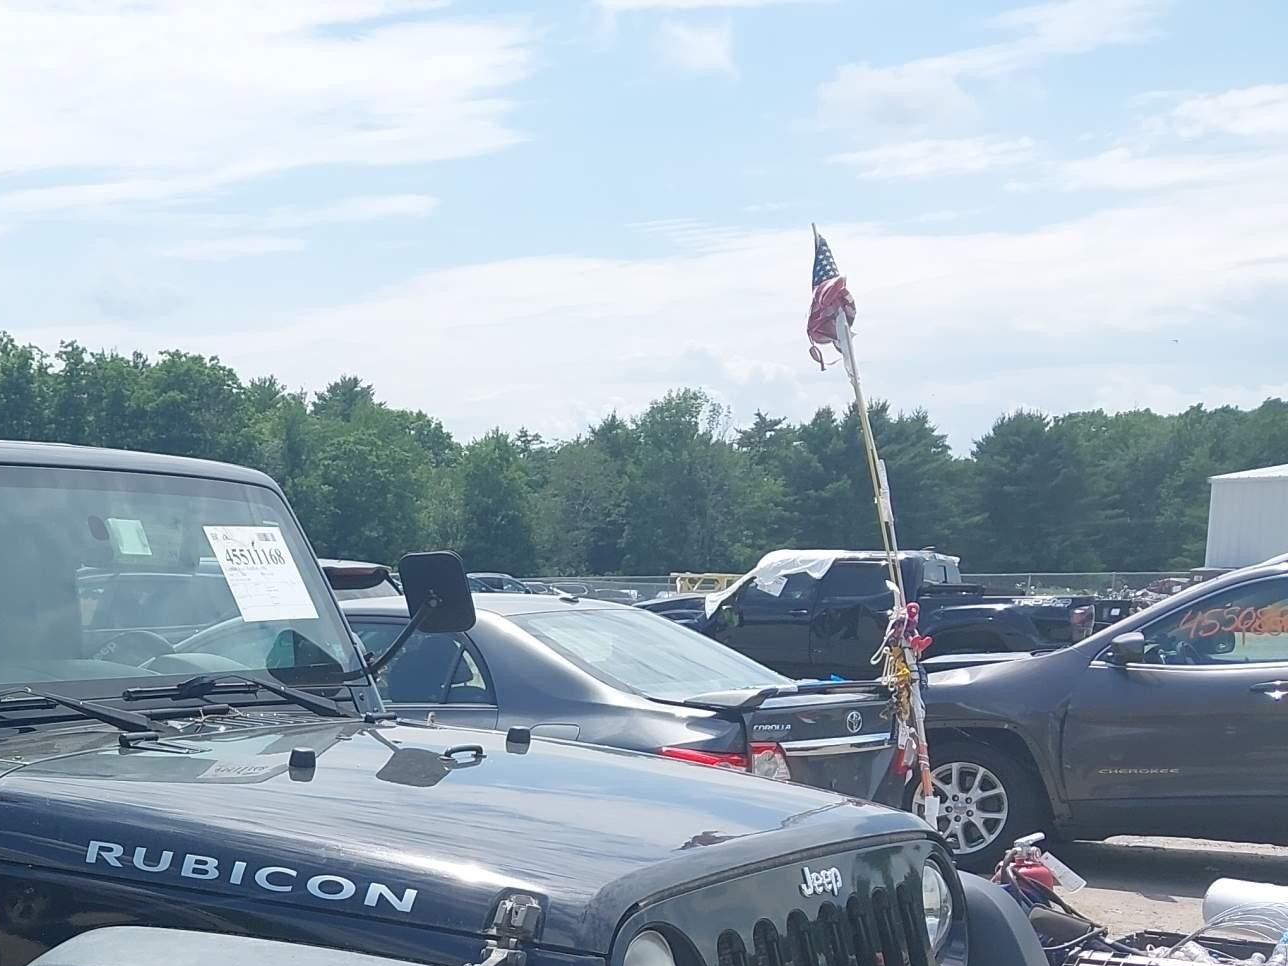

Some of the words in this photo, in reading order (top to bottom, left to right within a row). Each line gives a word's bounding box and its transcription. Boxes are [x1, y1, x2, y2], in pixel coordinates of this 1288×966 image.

[224, 547, 286, 566] 45511168
[1097, 767, 1181, 775] CHEROKEE
[85, 840, 418, 913] RUBICON
[800, 866, 843, 897] Jeep
